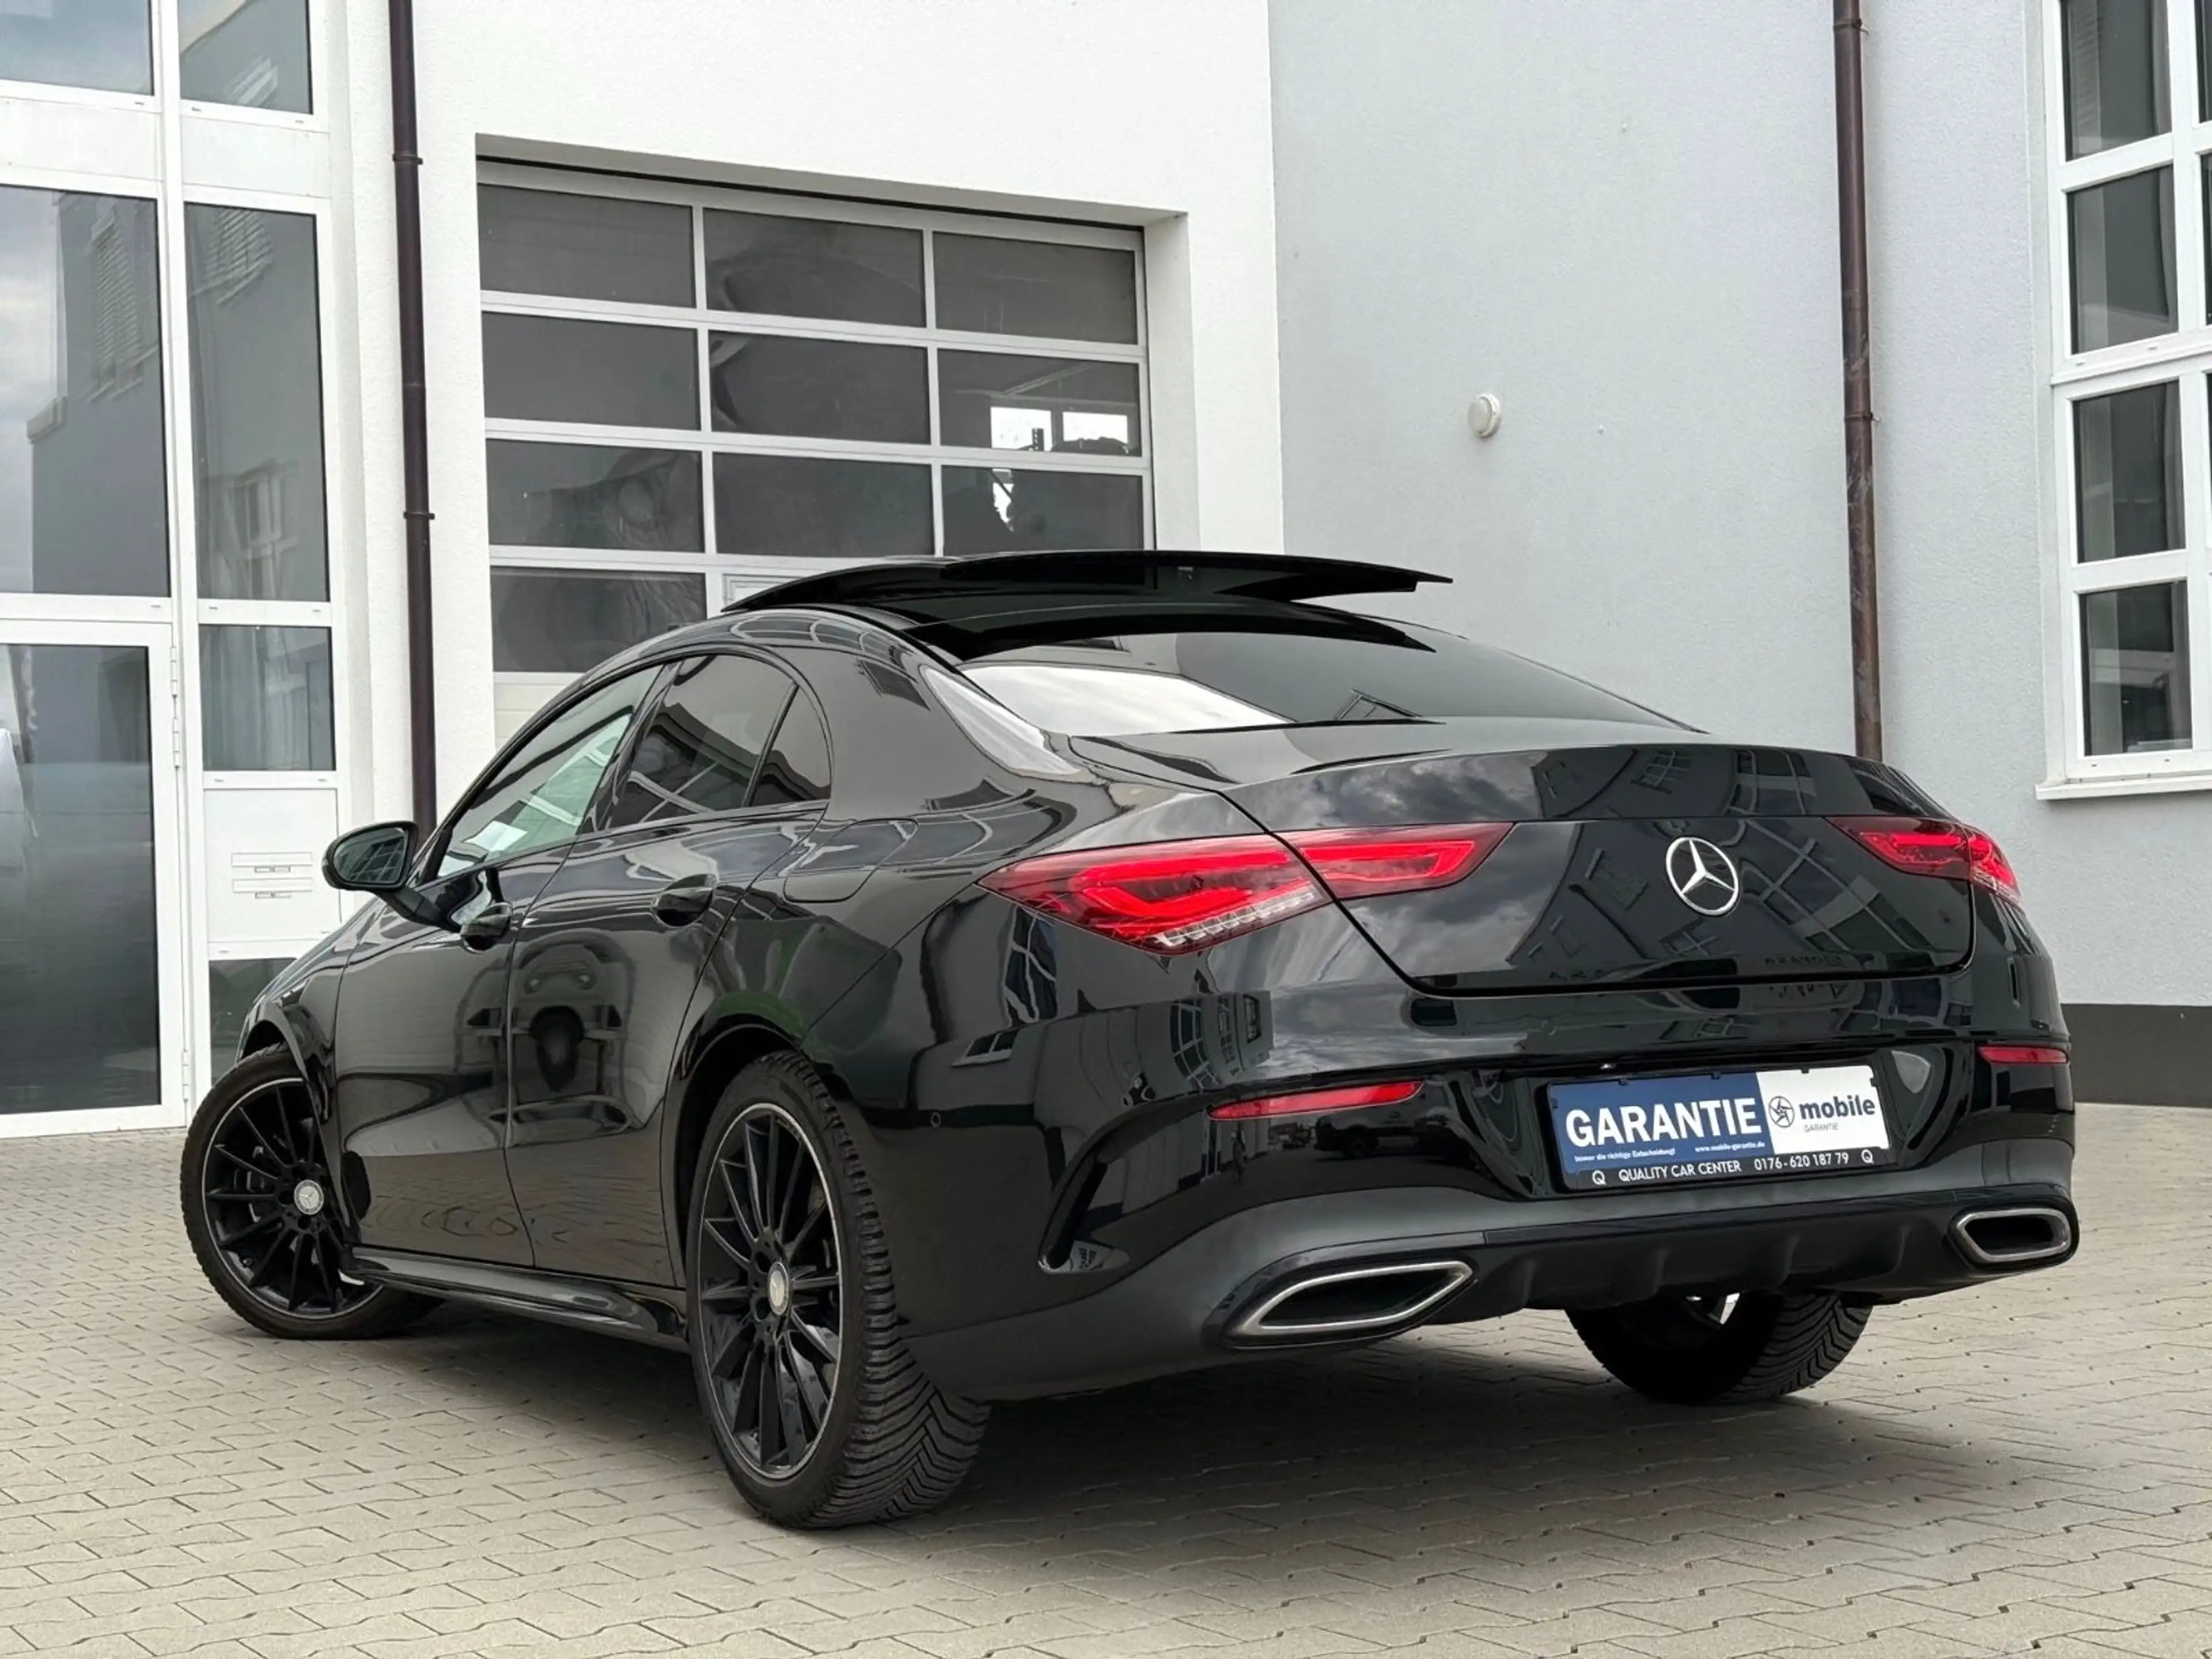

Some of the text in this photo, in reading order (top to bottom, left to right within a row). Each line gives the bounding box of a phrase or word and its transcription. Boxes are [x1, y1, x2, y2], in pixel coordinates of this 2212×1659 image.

[1799, 1094, 1876, 1119] mobile
[1566, 1097, 1762, 1147] GARANTIE
[1804, 1123, 1839, 1133] GARANTIE
[1592, 1170, 1606, 1185] Q
[1619, 1165, 1668, 1181] QUALITY
[1671, 1163, 1696, 1177] CAR
[1699, 1160, 1742, 1175] CENTER
[1813, 1153, 1832, 1166] 187
[1835, 1152, 1849, 1165] 79
[1861, 1149, 1874, 1164] Q
